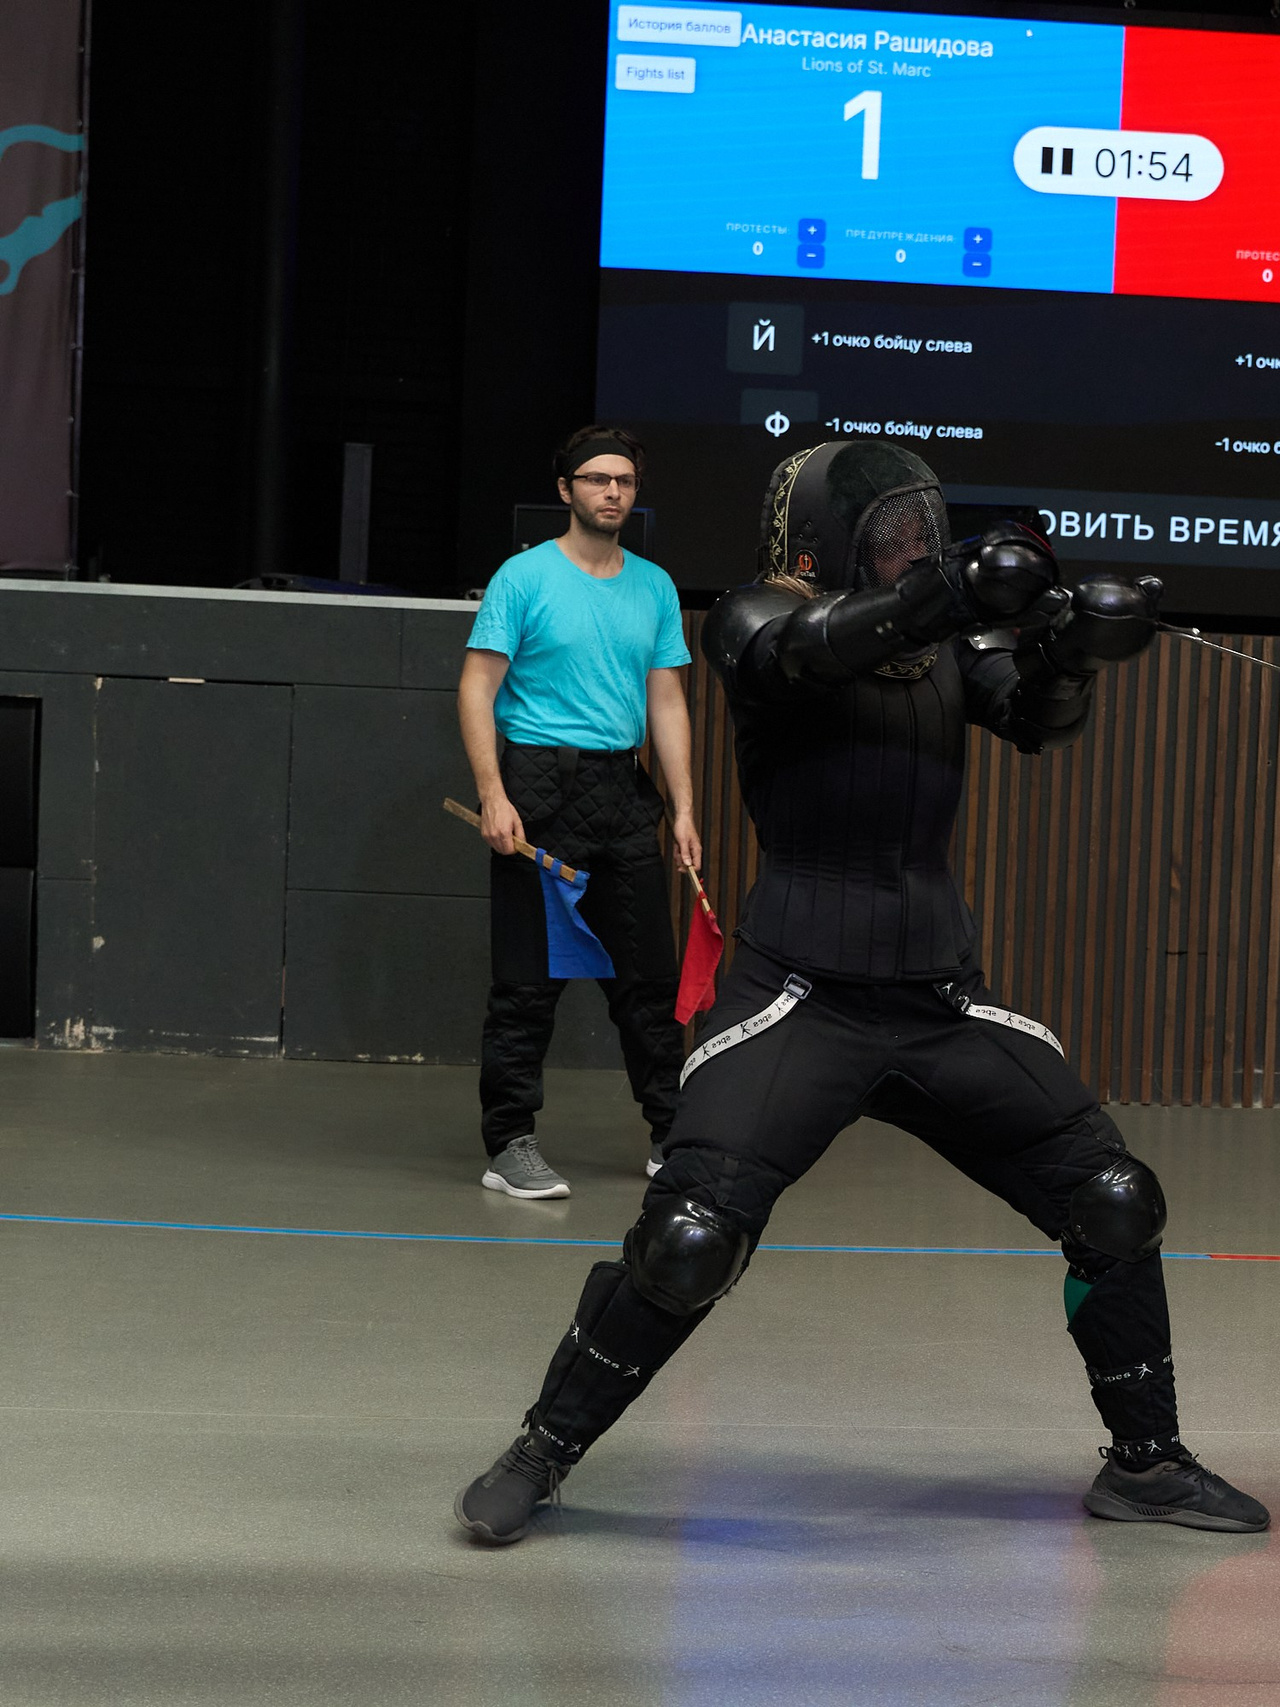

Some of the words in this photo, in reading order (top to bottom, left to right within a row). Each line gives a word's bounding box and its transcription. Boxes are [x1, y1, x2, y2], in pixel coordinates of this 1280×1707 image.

[628, 17, 682, 31] История
[686, 21, 731, 34] баллов
[742, 22, 867, 49] Анастасия
[874, 30, 994, 58] Рашидова
[627, 66, 664, 80] Fights
[668, 69, 685, 80] list
[802, 57, 843, 73] Lions
[847, 60, 863, 73] of
[868, 60, 888, 75] St.
[893, 62, 931, 77] Marc
[843, 90, 882, 180] 1
[1095, 148, 1193, 182] 01:54
[752, 241, 763, 256] 0
[895, 249, 907, 263] 0
[1261, 268, 1274, 283] 0
[752, 318, 776, 352] Й
[811, 331, 829, 347] +1
[832, 334, 870, 349] очко
[873, 332, 922, 354] бойцу
[925, 339, 973, 354] слева
[1235, 354, 1253, 369] +1
[764, 410, 791, 437] Ф
[825, 417, 840, 432] -1
[843, 420, 882, 435] очко
[884, 419, 933, 440] бойцу
[935, 425, 984, 440] слева
[1215, 438, 1230, 452] -1
[1233, 440, 1270, 455] очко
[1038, 509, 1155, 542] ОВИТЬ
